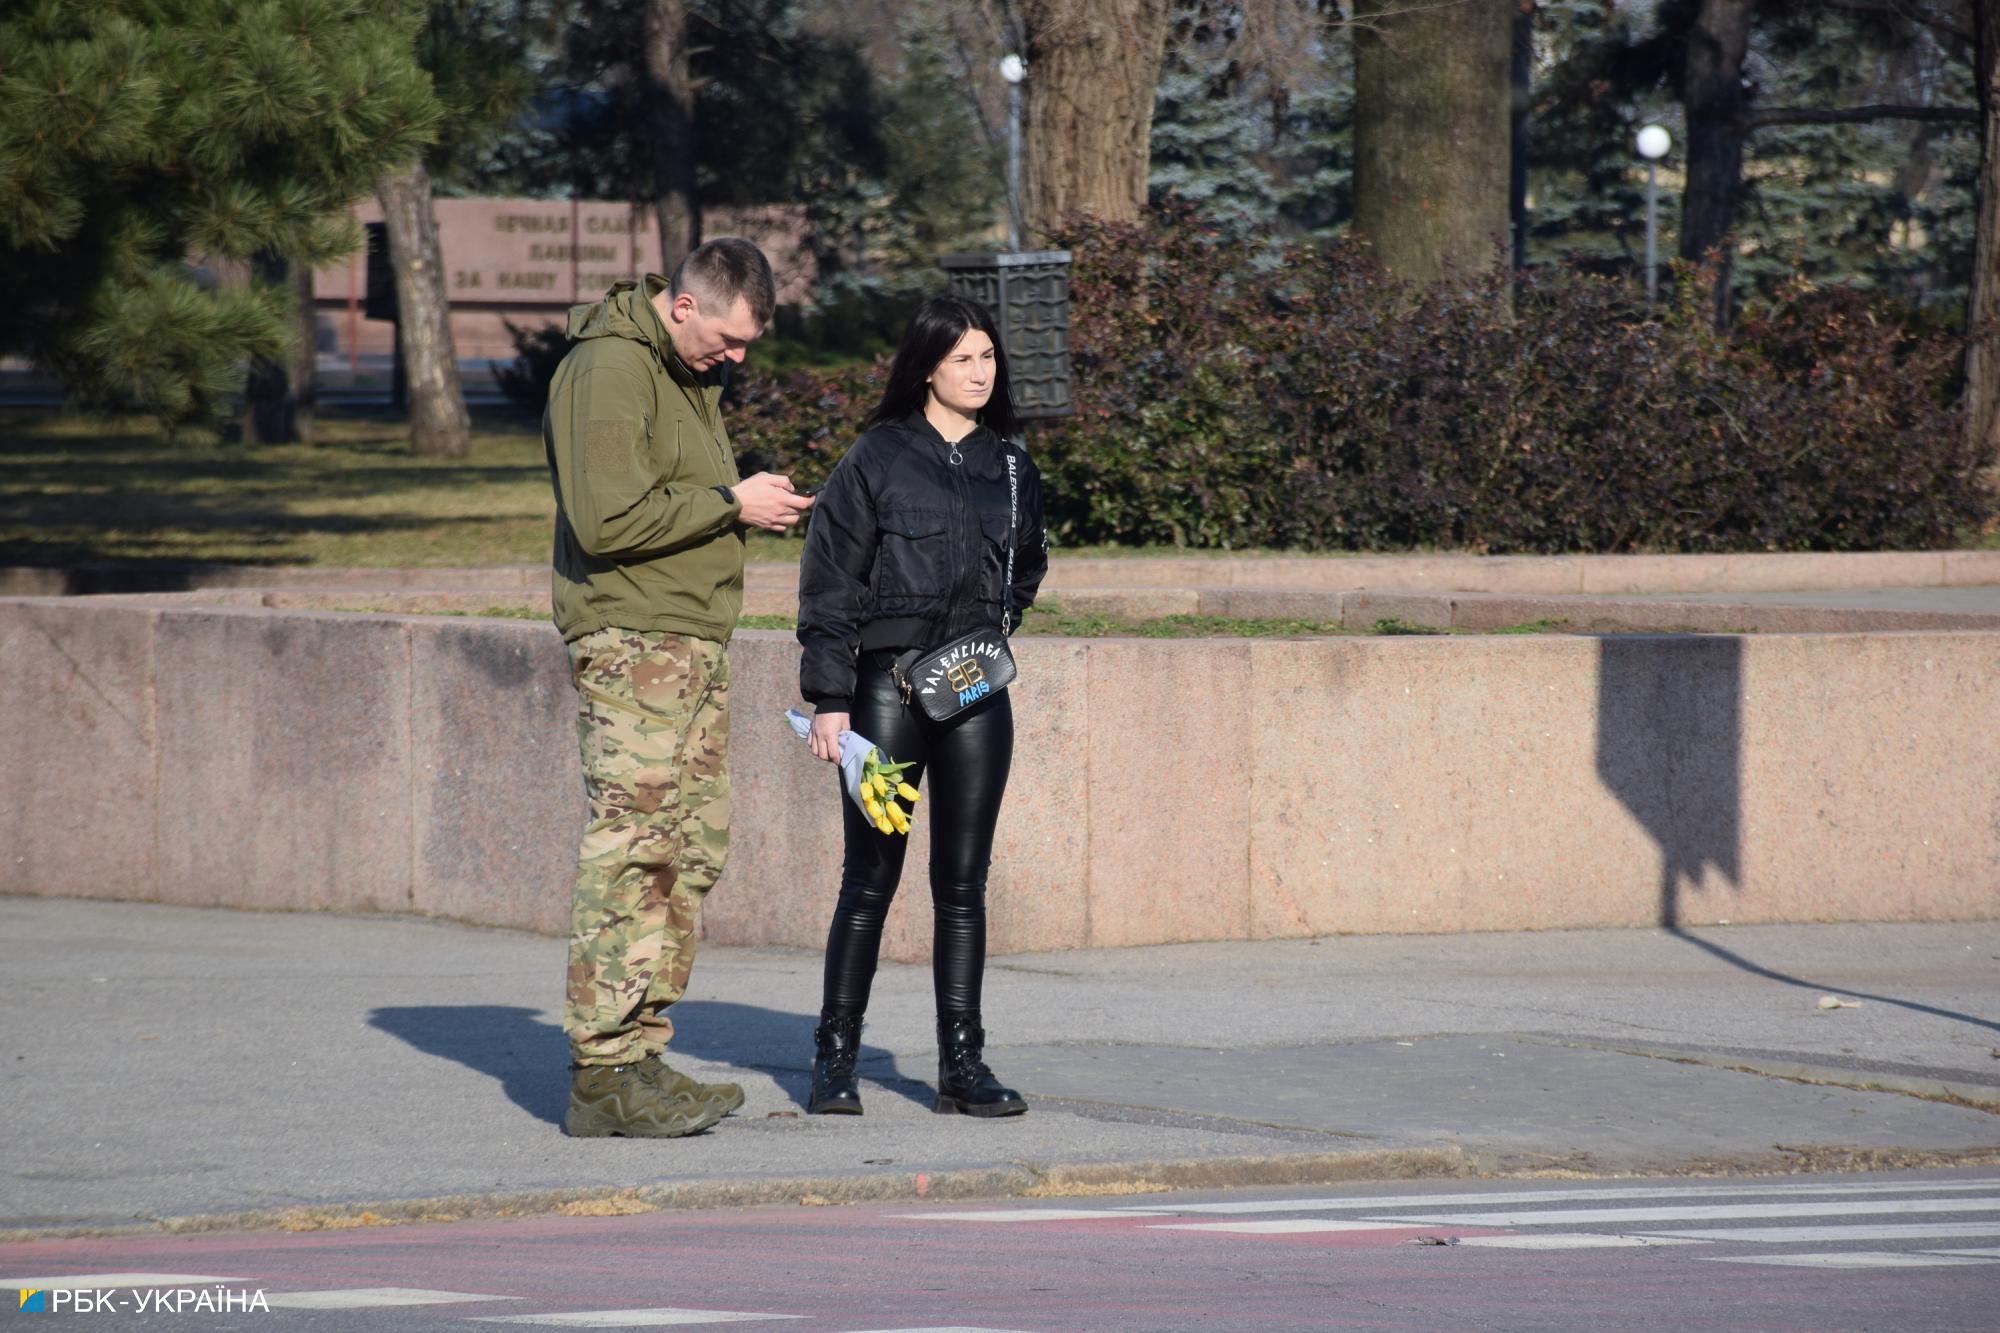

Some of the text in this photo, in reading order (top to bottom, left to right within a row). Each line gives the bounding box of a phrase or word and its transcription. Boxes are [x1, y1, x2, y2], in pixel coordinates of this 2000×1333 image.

[456, 271, 482, 289] ЗА
[1006, 454, 1017, 528] BALENCIAGA
[921, 642, 1001, 694] BALENCIAGA
[959, 681, 990, 707] PARIS
